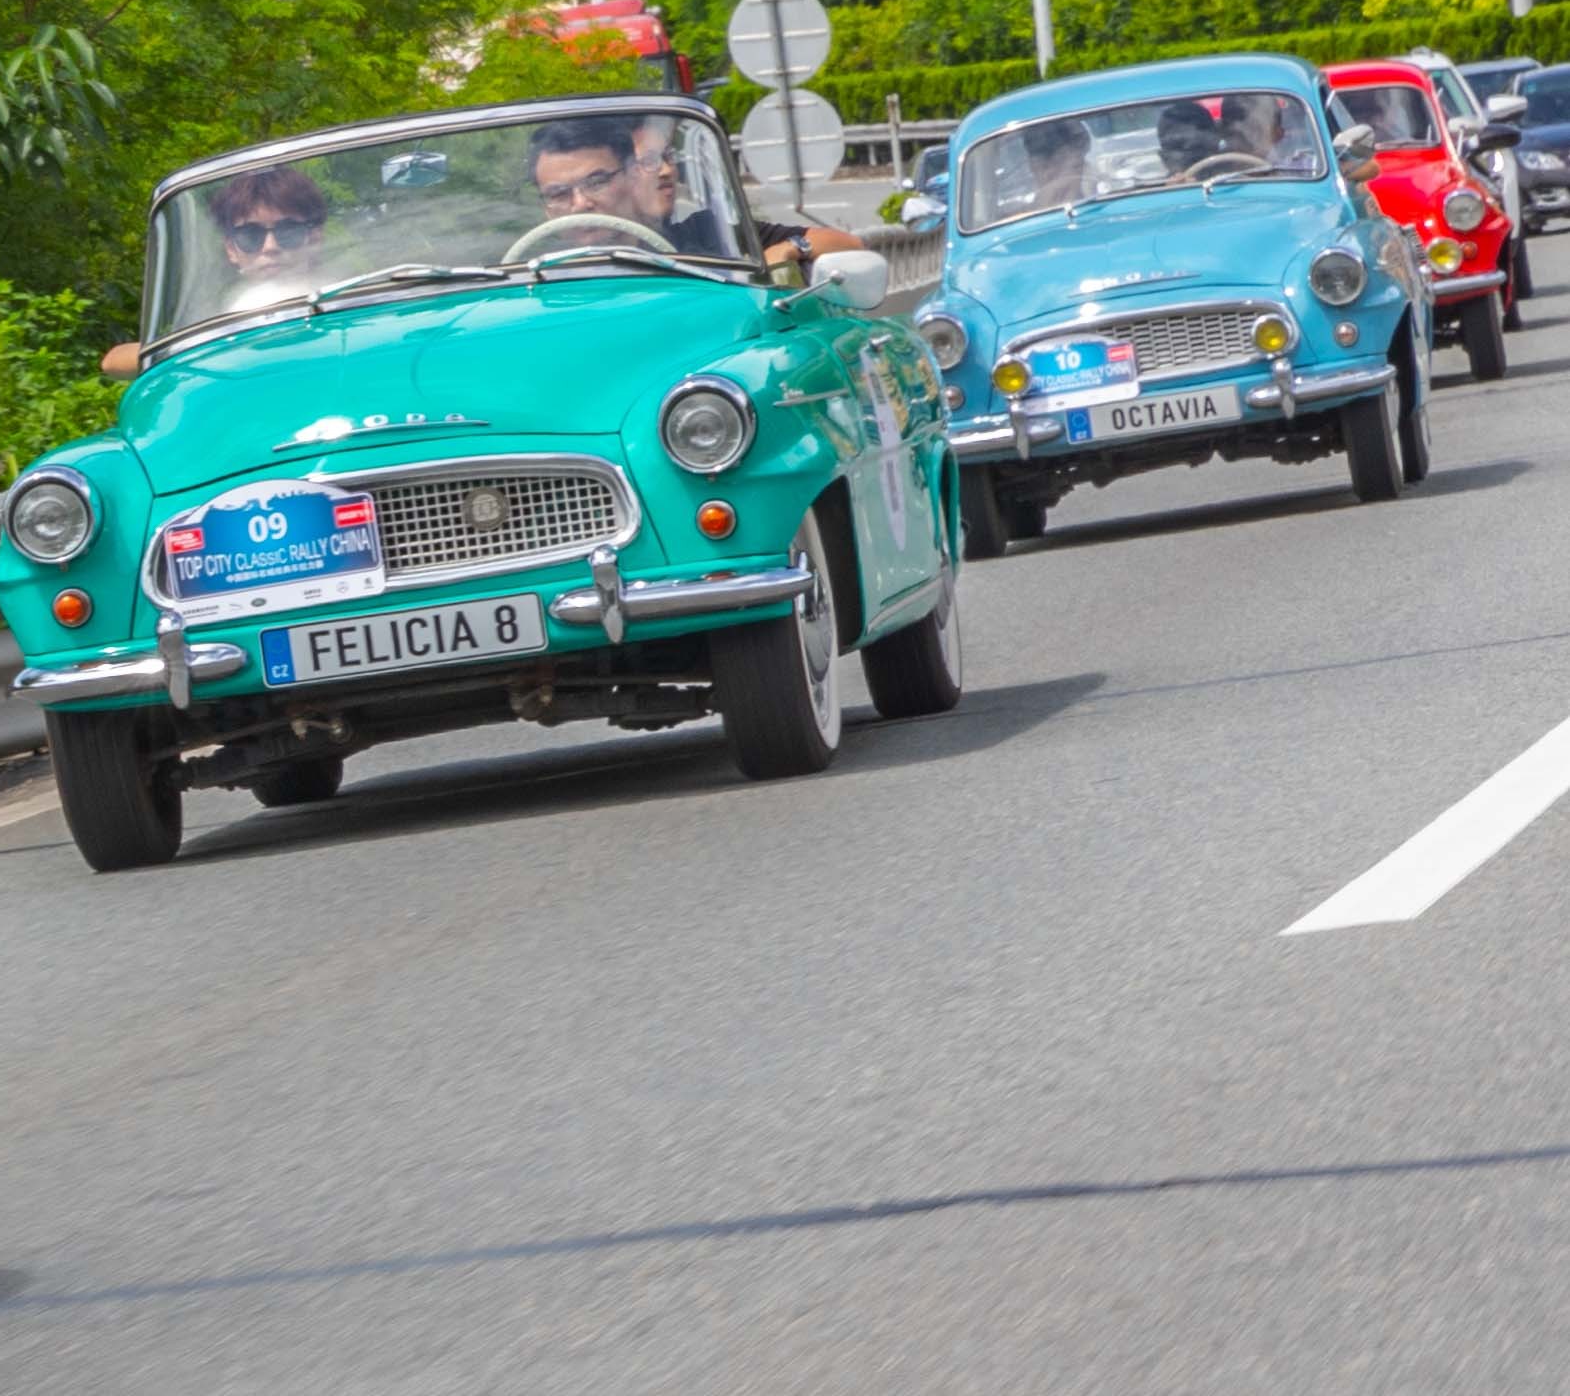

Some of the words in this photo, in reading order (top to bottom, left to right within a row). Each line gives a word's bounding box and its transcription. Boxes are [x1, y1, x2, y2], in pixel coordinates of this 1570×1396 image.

[1055, 350, 1081, 371] 10
[1112, 396, 1217, 430] OCTAVIA
[247, 512, 288, 543] 09
[176, 557, 203, 581] TOP
[204, 553, 233, 577] CITY
[234, 549, 288, 571] CLASSIC
[289, 538, 329, 560] RALLY
[329, 527, 372, 556] CHINA
[308, 610, 478, 672] FELICIA
[494, 605, 519, 643] 8
[271, 664, 288, 679] CZ
